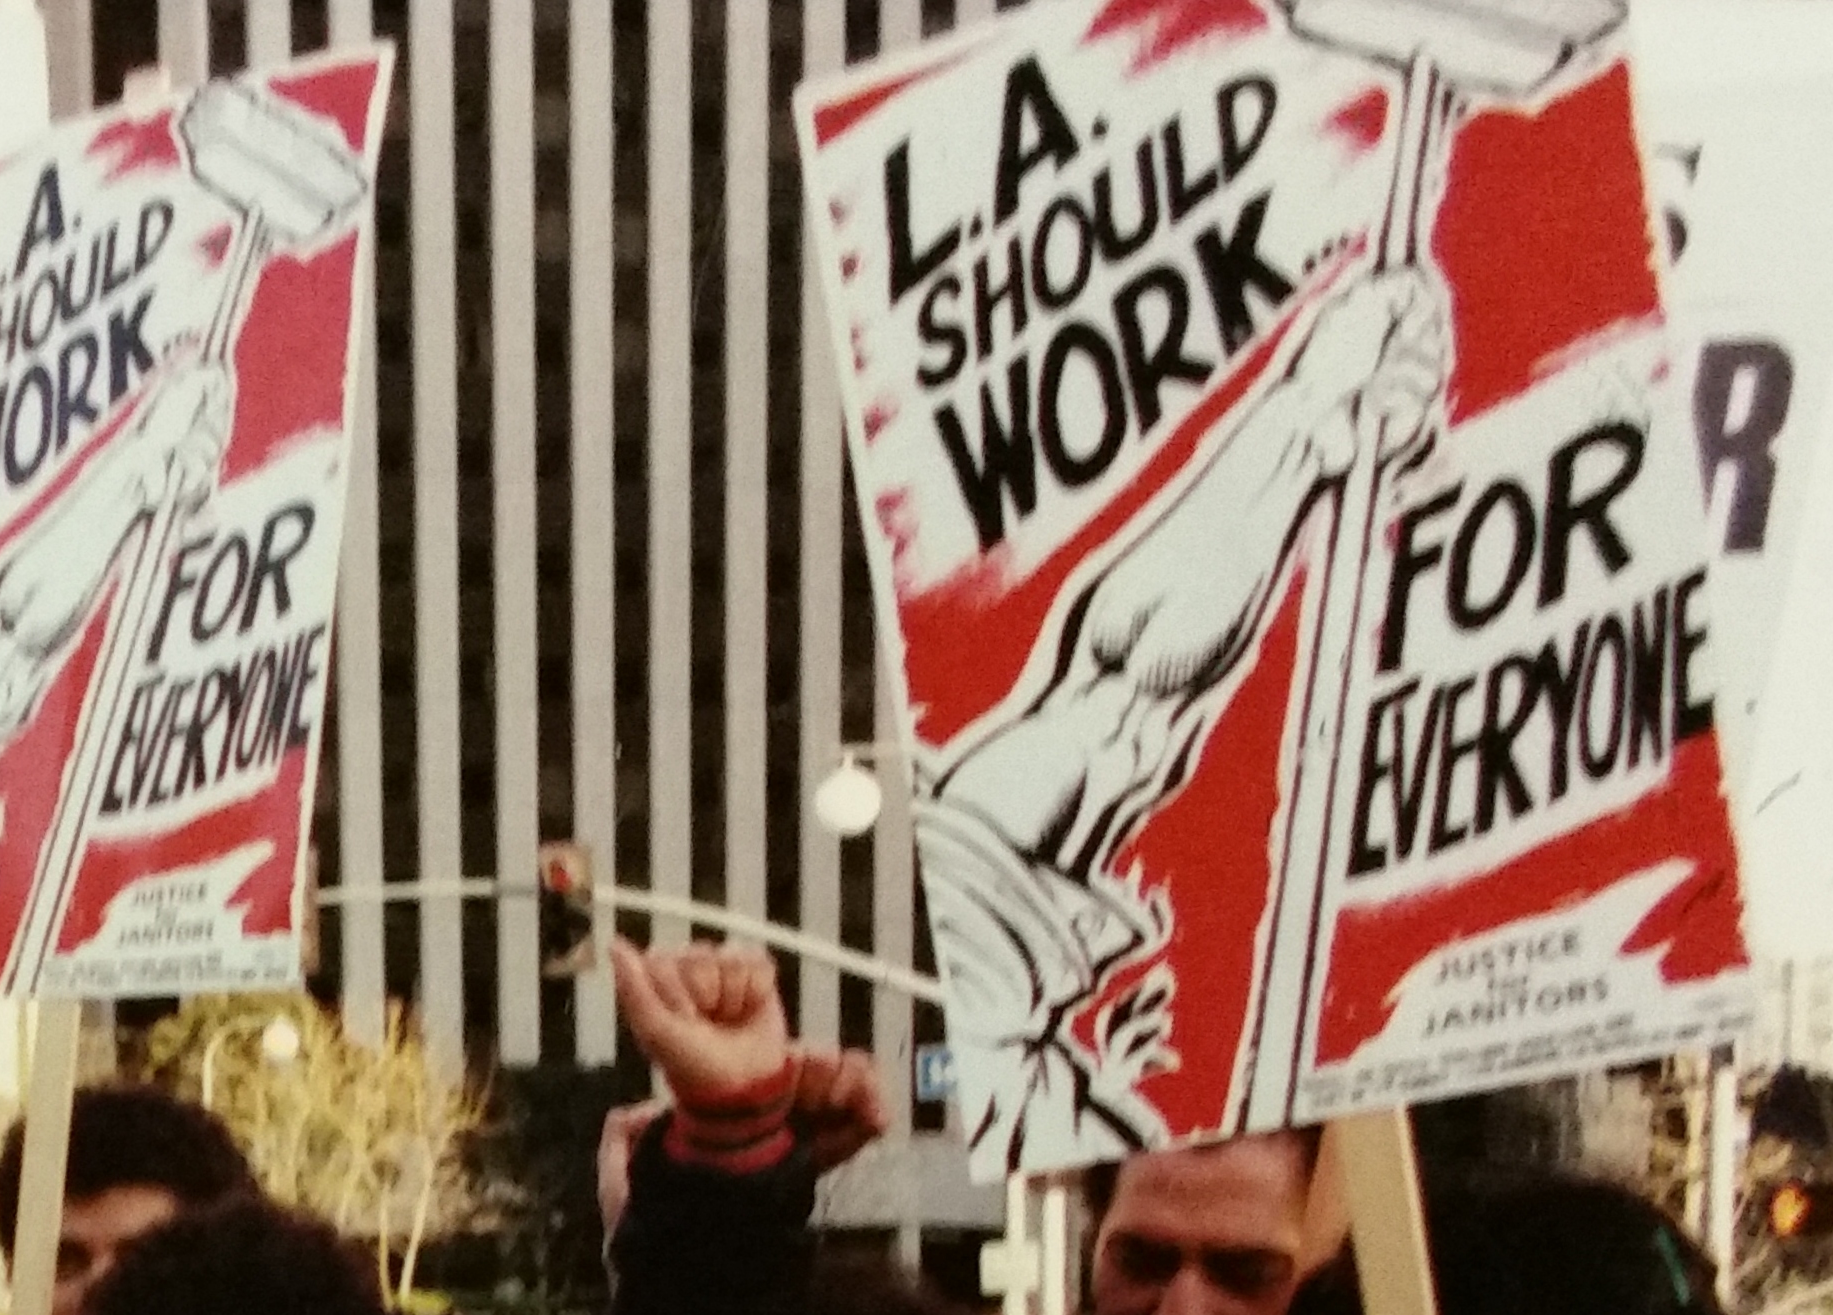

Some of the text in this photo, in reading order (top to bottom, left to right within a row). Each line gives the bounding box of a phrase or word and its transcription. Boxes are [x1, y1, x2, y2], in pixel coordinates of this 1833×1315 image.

[885, 56, 1109, 308] L.A.
[917, 72, 1276, 388] SHOULD
[147, 503, 314, 666] FOR
[1376, 418, 1650, 671] FOR
[98, 624, 325, 819] EVERYONE
[1346, 571, 1715, 877] EVERYONE
